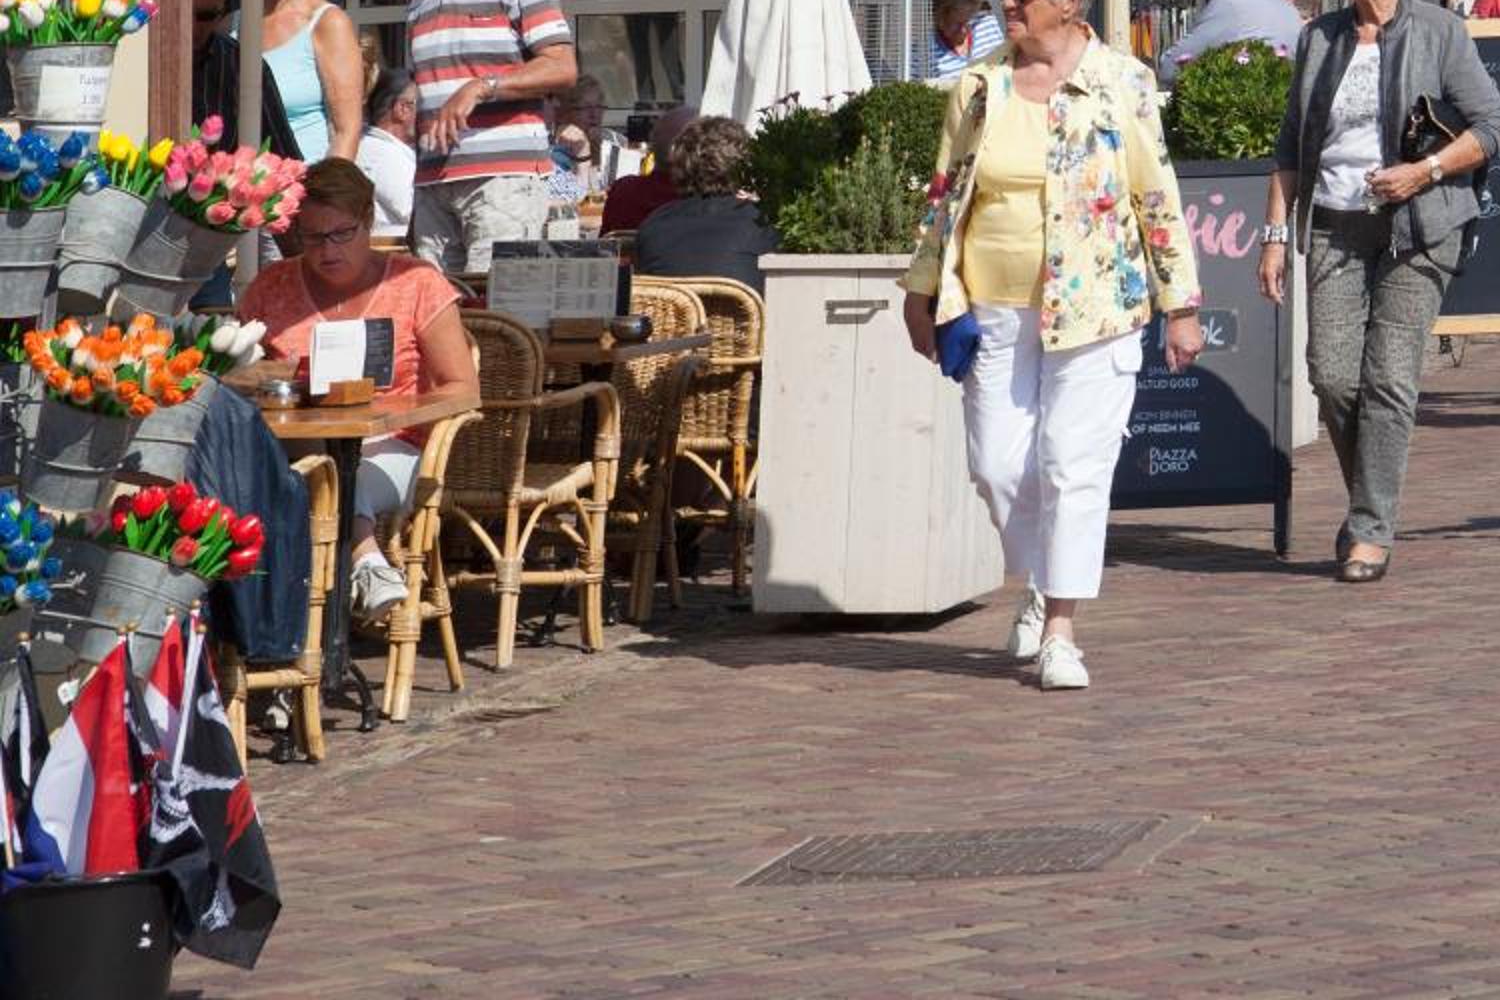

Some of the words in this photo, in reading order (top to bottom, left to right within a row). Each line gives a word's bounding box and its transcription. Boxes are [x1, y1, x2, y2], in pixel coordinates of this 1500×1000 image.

[1169, 377, 1199, 390] GOED
[1131, 423, 1146, 433] OF
[1149, 447, 1198, 461] PIAZZA
